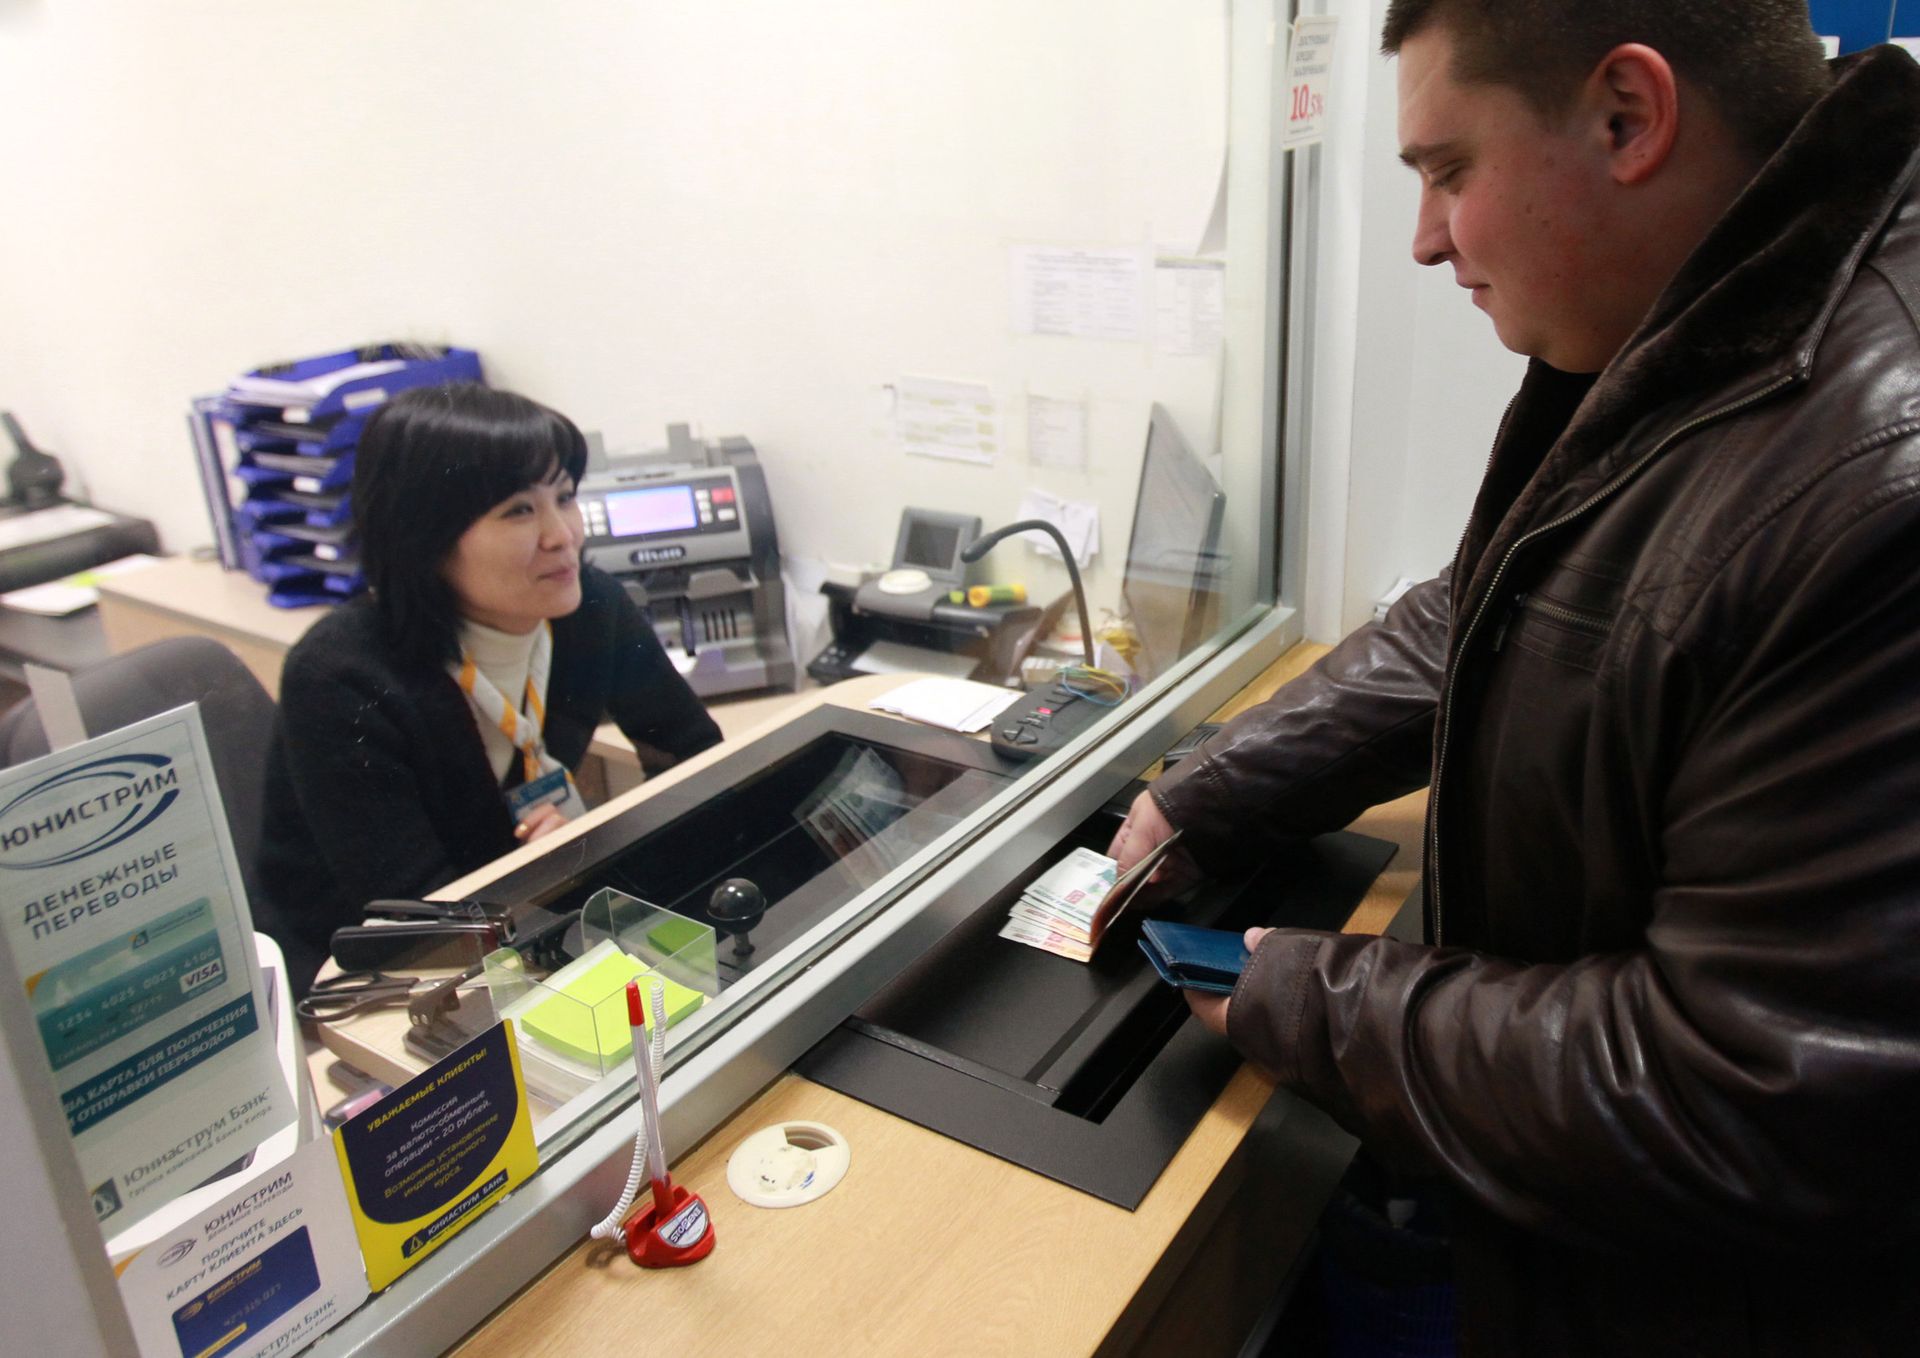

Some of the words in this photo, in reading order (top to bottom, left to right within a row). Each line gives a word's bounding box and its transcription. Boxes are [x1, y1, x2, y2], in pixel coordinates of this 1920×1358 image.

[1, 767, 177, 850] ЮНИСТРИМ
[23, 843, 177, 925] ДЕНЕЖНЫЕ
[33, 864, 178, 940] ПЕРЕВОДЫ
[186, 962, 220, 987] VISA
[77, 1072, 155, 1122] ОТПРАВКИ
[157, 1026, 235, 1077] ПЕРЕВОДОВ
[87, 1069, 135, 1100] КАРТА
[137, 1049, 164, 1075] ДЛЯ
[166, 1004, 249, 1057] ПОЛУЧЕНИЯ
[367, 1082, 436, 1133] УВАЖАЕМЫЕ
[437, 1048, 487, 1086] КЛИЕНТЫ!
[386, 1150, 398, 1164] за
[400, 1090, 485, 1153] валюто-обменные
[410, 1096, 458, 1132] Комиссия
[124, 1117, 227, 1187] Юниаструм
[384, 1140, 433, 1178] операции
[442, 1123, 455, 1138] 20
[384, 1159, 435, 1198] Возможно
[437, 1113, 499, 1162] установление
[404, 1135, 486, 1197] индивидуального
[205, 1171, 292, 1234] ЮНИСТРИМ
[427, 1192, 480, 1235] ЮНИАСТРУМ
[482, 1174, 504, 1195] БАНК
[166, 1267, 207, 1302] КАРТУ
[209, 1234, 265, 1273] КЛИЕНТА
[268, 1207, 303, 1234] ЗДЕСЬ
[201, 1218, 266, 1266] ПОЛУЧИТЕ
